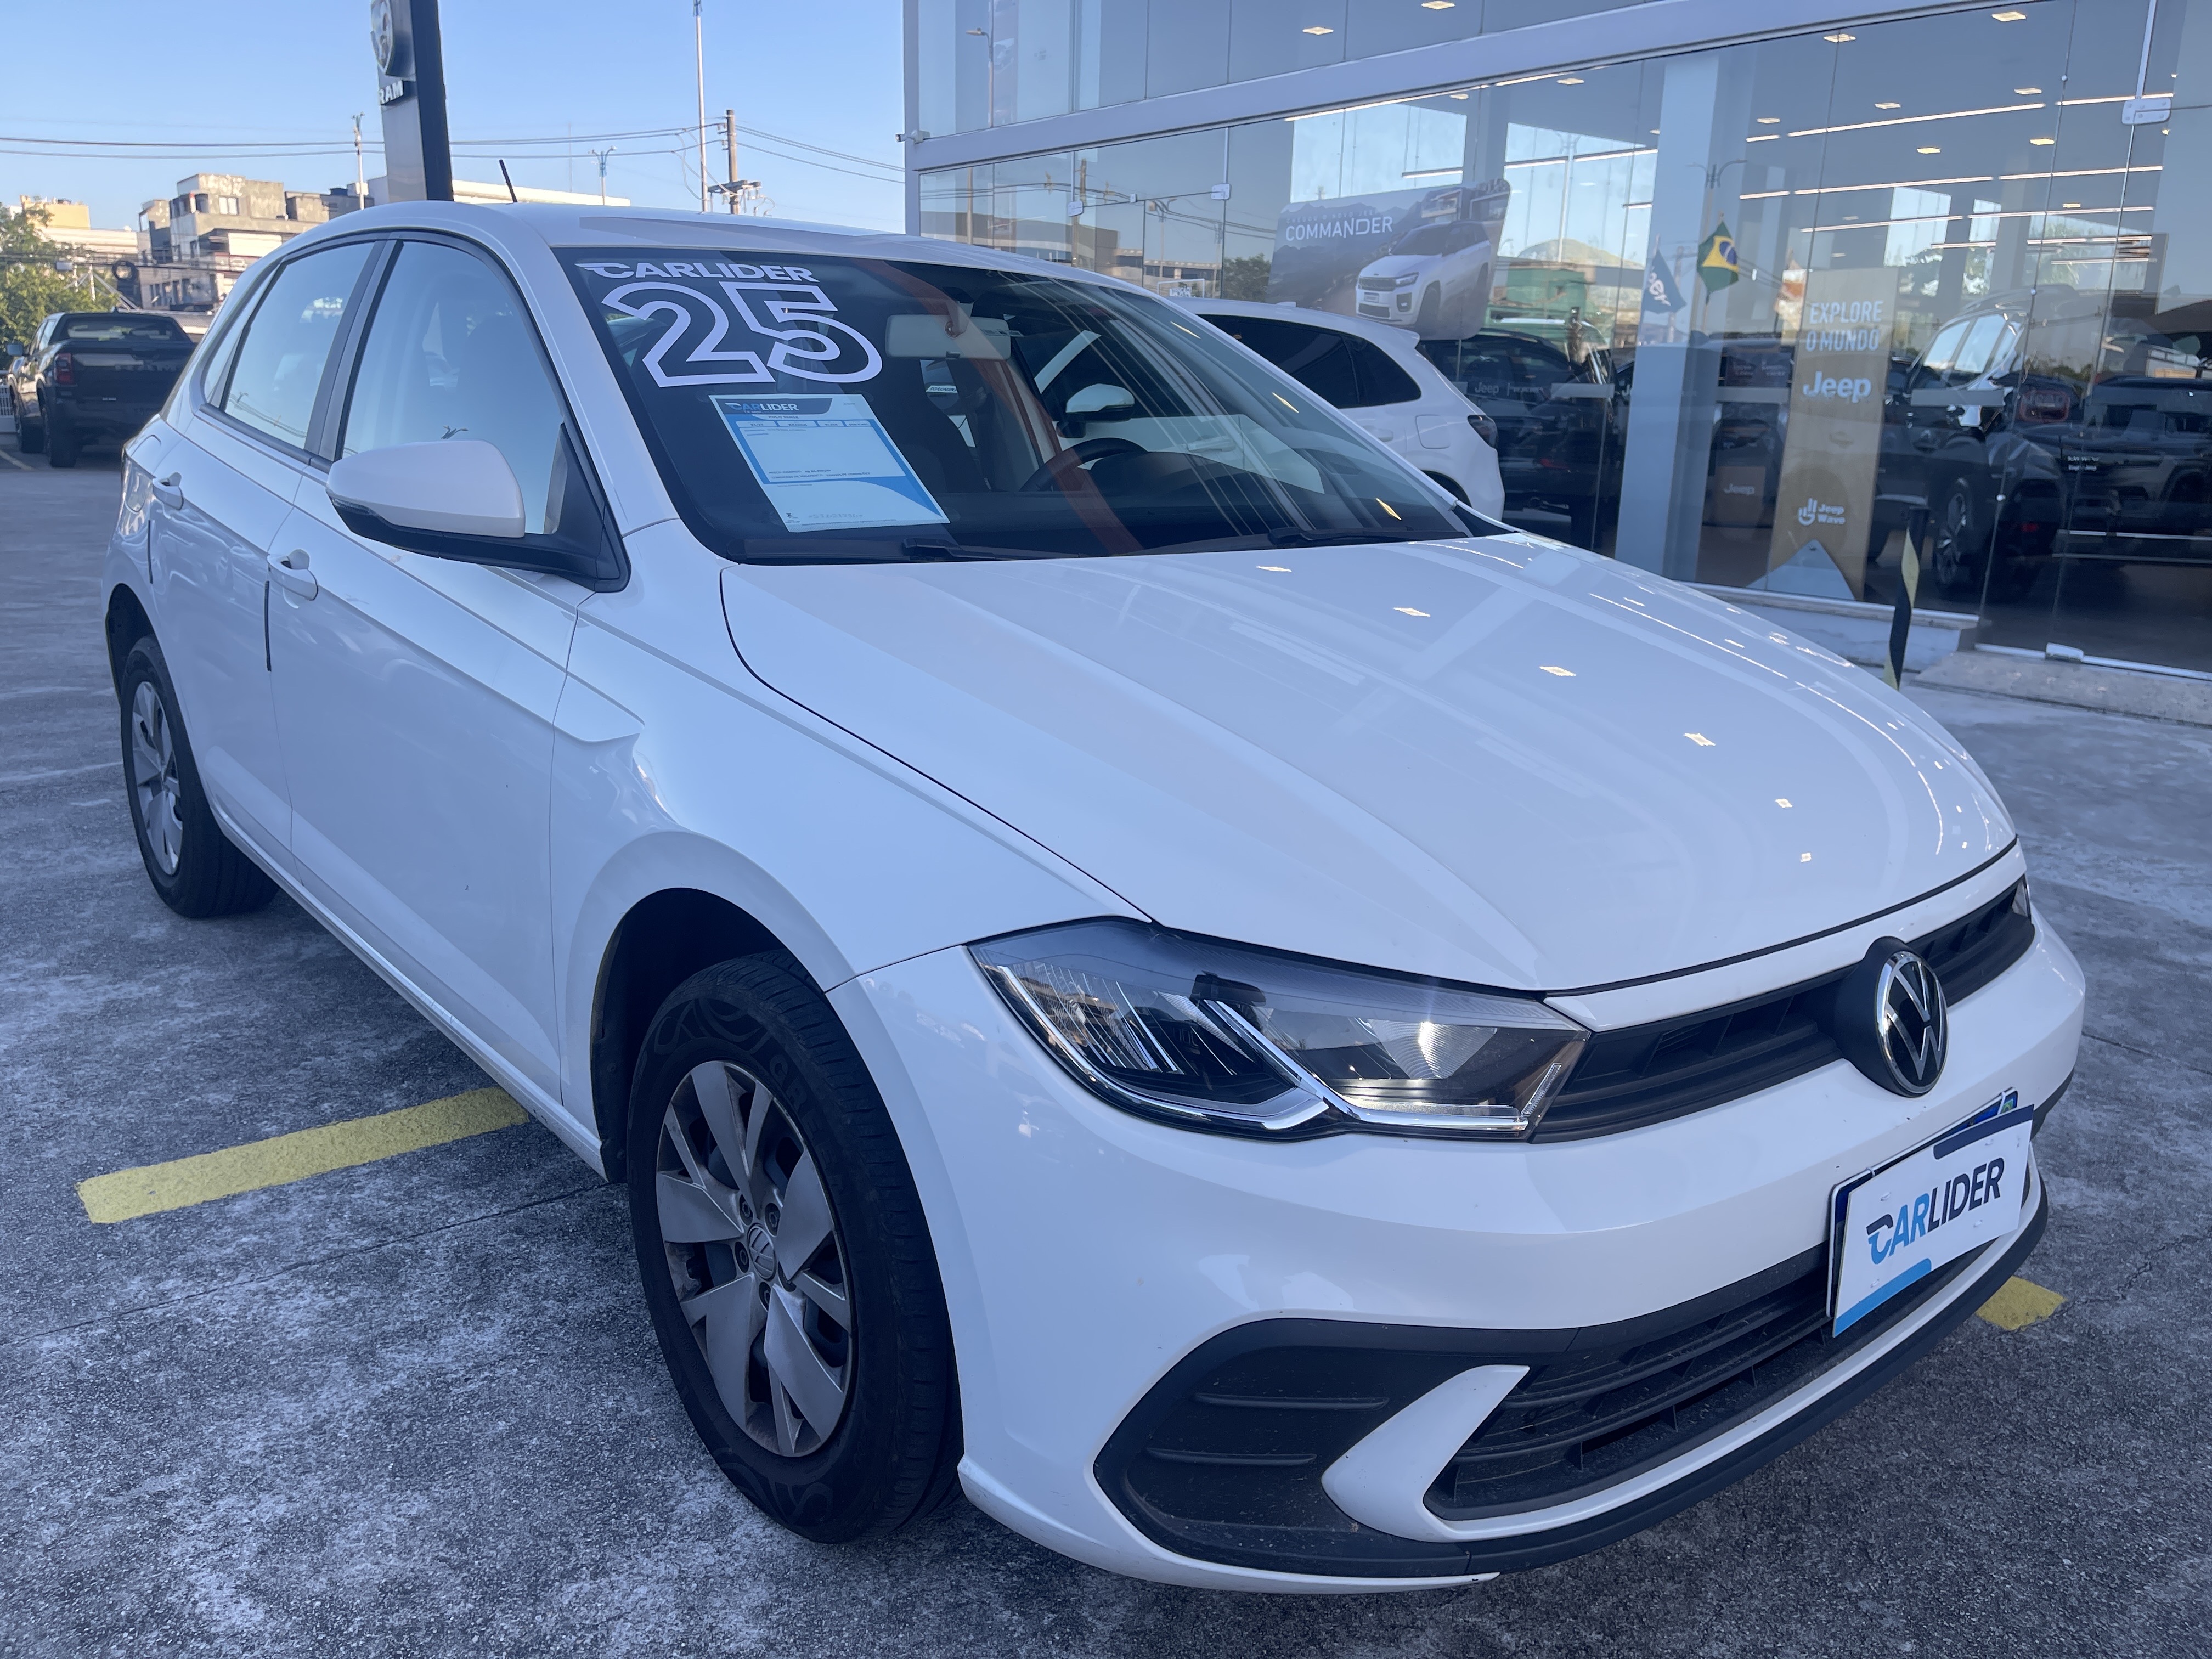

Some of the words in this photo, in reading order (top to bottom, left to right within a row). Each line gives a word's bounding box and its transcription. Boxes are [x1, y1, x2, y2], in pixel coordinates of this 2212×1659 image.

[378, 79, 404, 105] RAM
[1285, 216, 1393, 241] COMMANDER
[574, 262, 820, 283] CARLIDER
[1809, 300, 1884, 325] EXPLORE
[601, 280, 883, 388] 25
[1805, 330, 1818, 352] O
[1819, 329, 1880, 352] MUNDO
[1802, 370, 1872, 404] Jeep
[724, 402, 799, 411] CARLIDER
[1818, 503, 1844, 515] Jeep
[1818, 514, 1846, 525] Wave
[1866, 1156, 2005, 1265] CARLIDER
